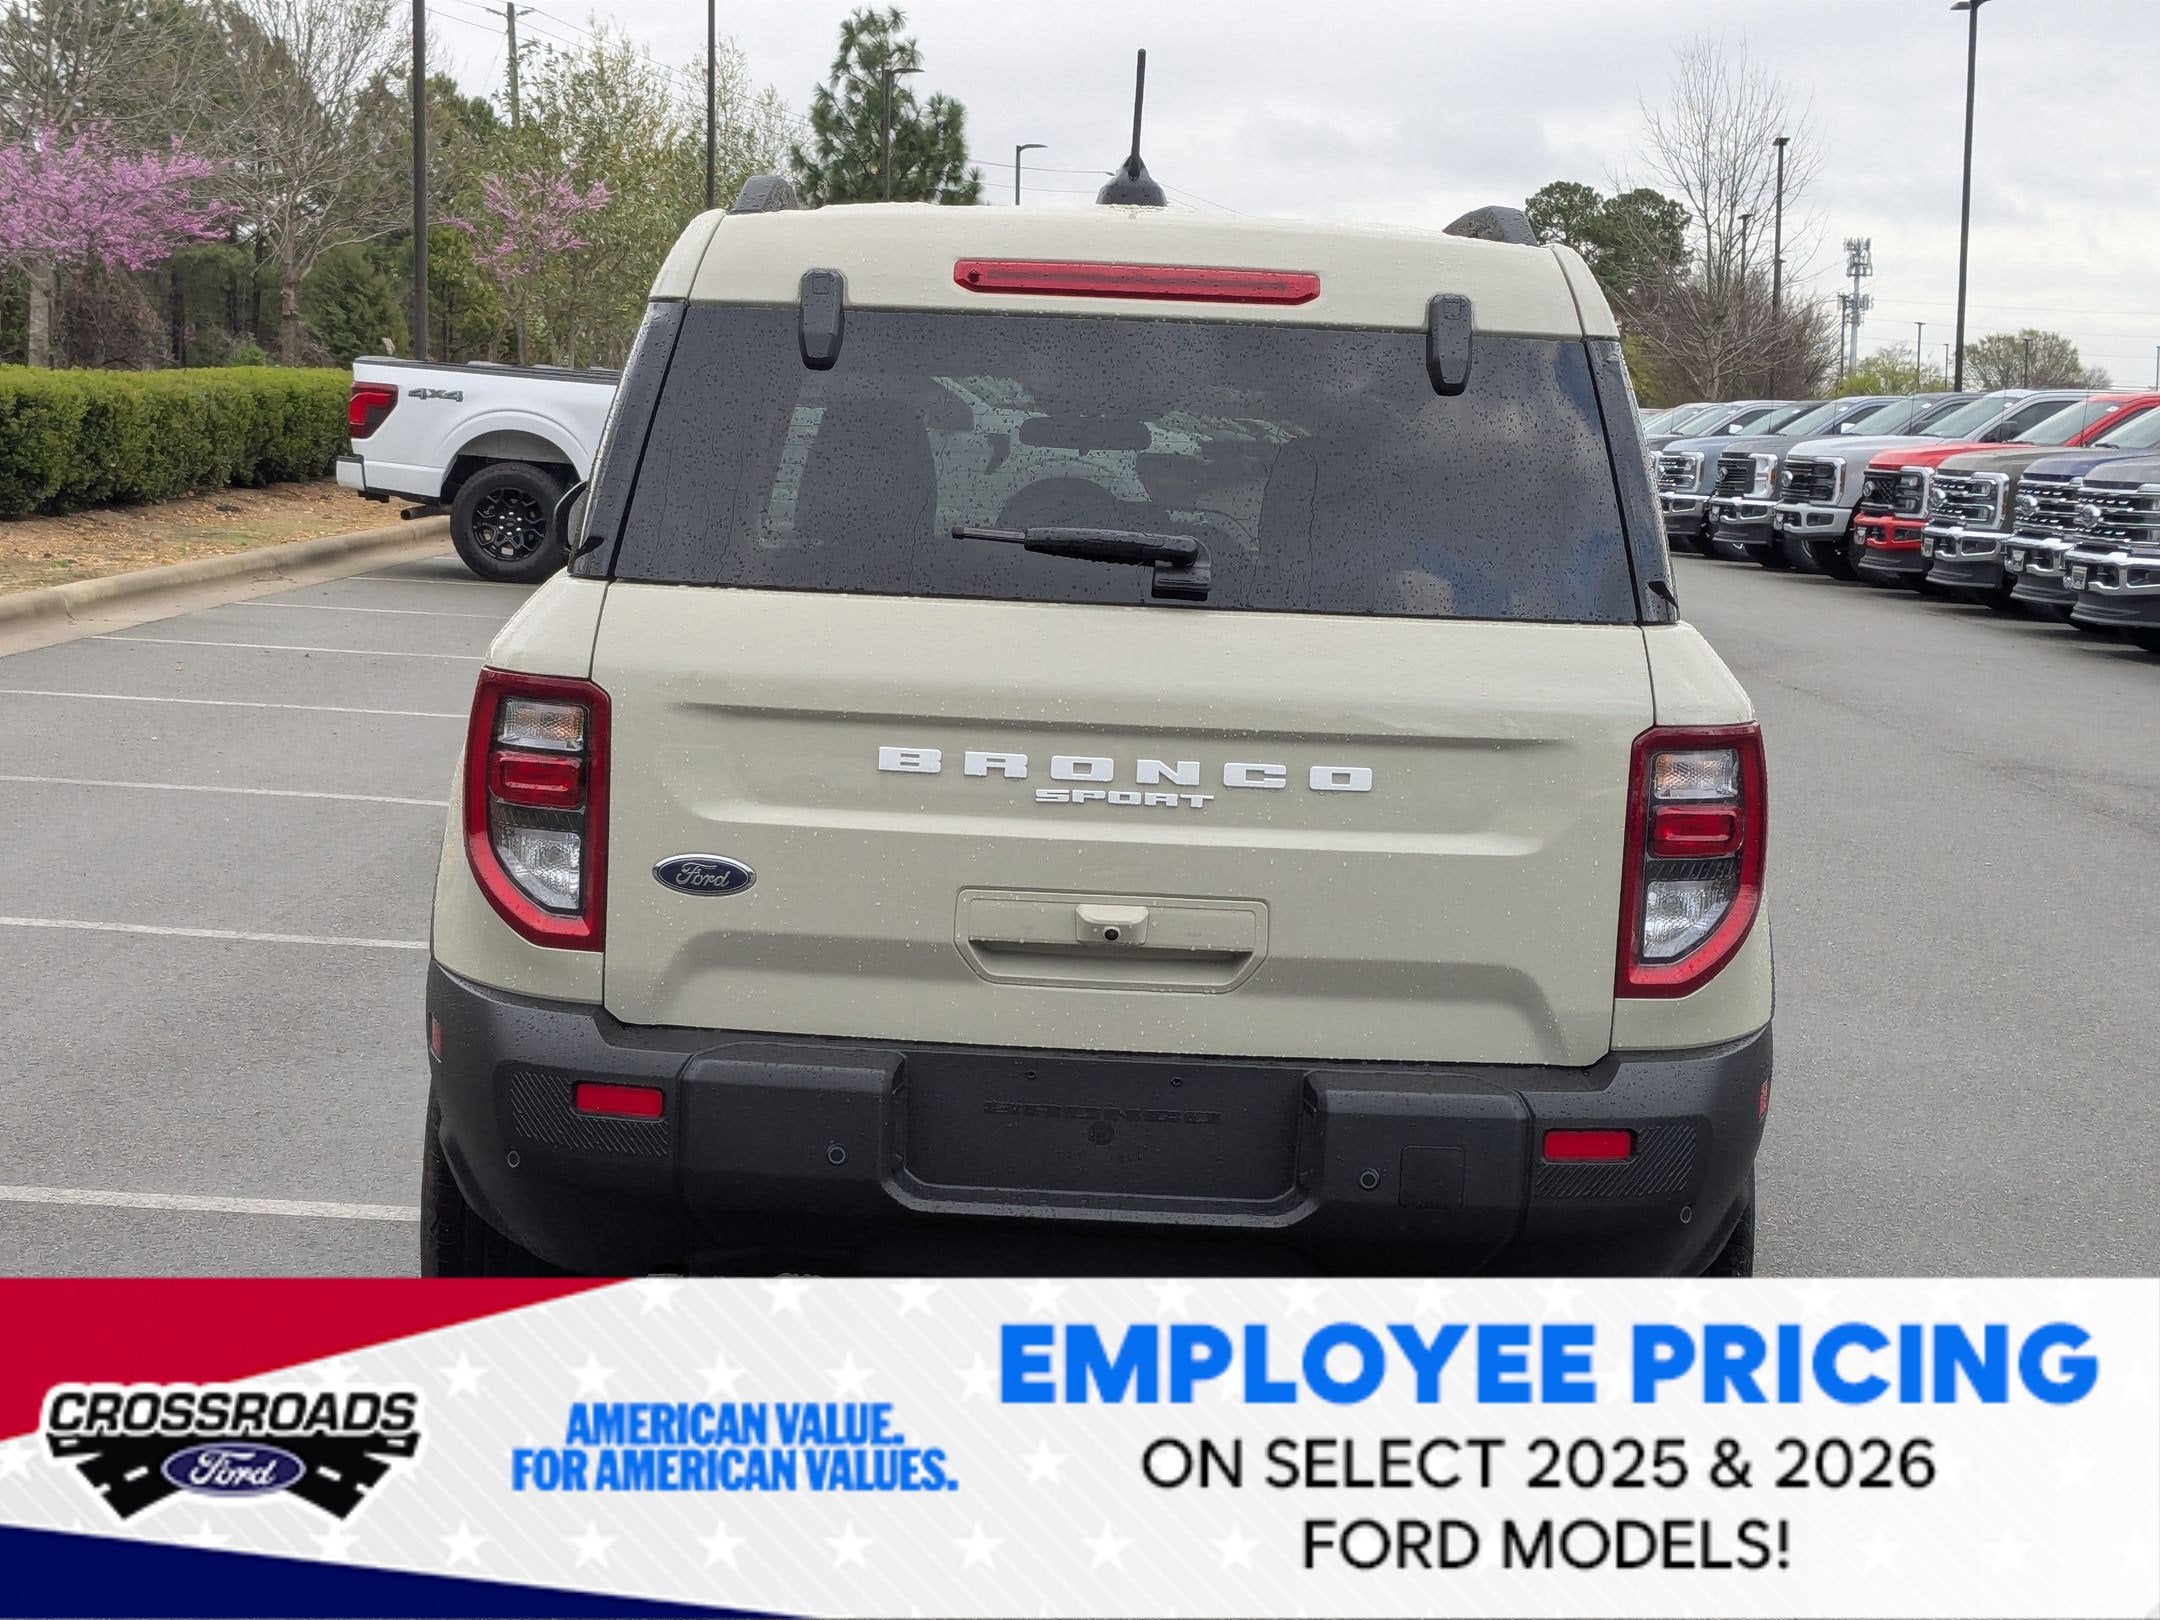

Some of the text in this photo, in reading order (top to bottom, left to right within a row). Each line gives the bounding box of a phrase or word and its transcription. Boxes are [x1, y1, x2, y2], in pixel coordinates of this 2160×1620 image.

[878, 746, 1373, 792] BRONCO
[1035, 788, 1215, 808] SPORT
[676, 862, 732, 887] Ford
